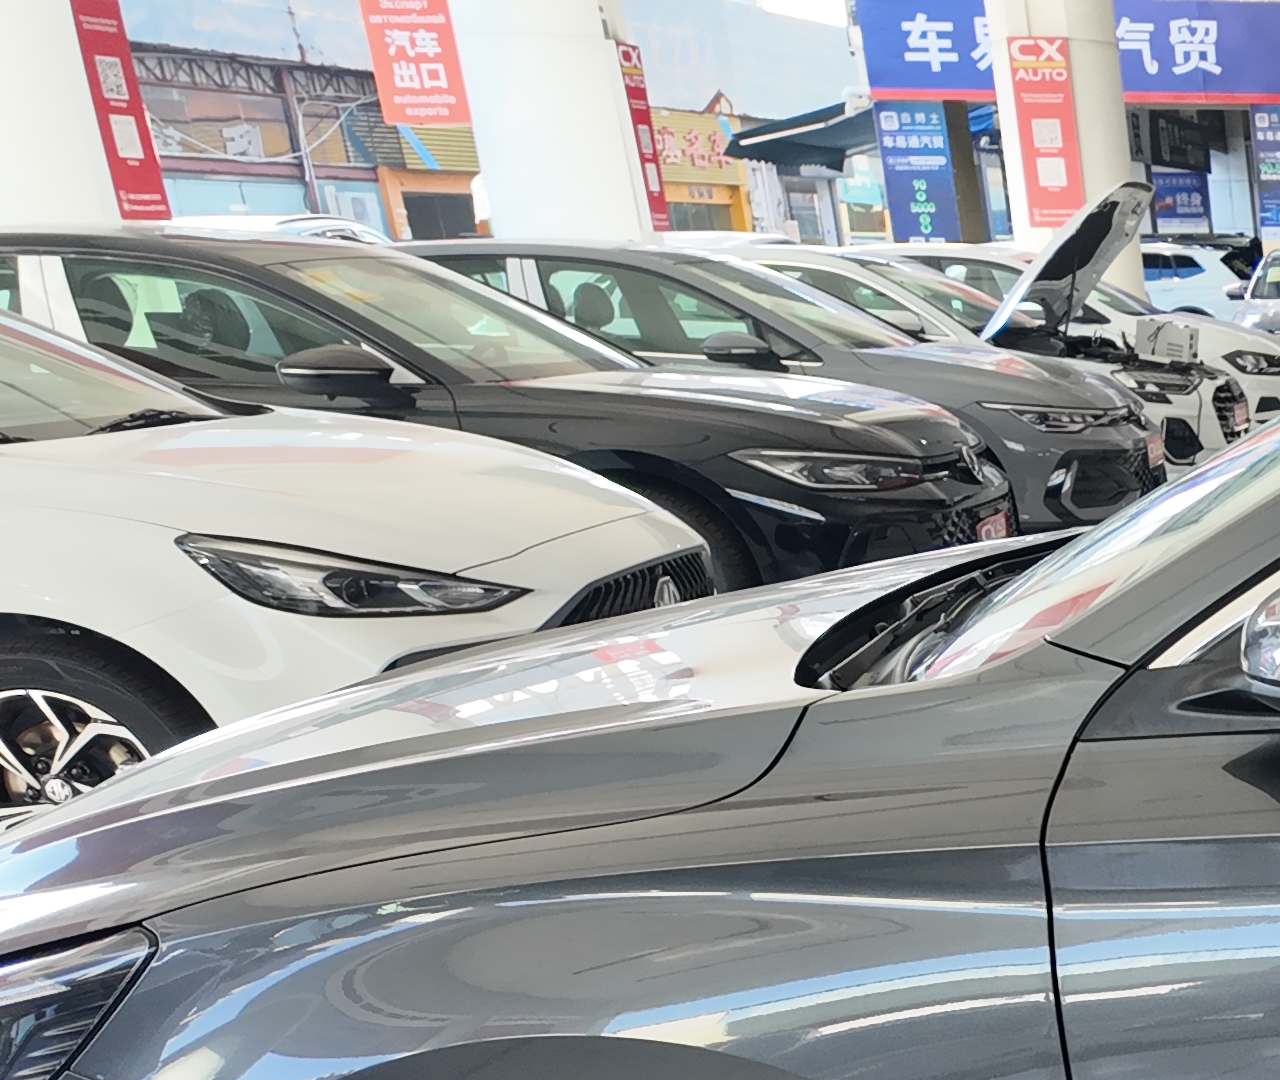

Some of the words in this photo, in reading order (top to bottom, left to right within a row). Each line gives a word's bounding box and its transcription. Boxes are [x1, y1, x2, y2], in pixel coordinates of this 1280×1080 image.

[384, 28, 443, 58] 汽车
[1010, 38, 1064, 61] CX
[618, 45, 642, 69] CX
[392, 60, 449, 90] 出口
[1014, 68, 1068, 83] AUTO
